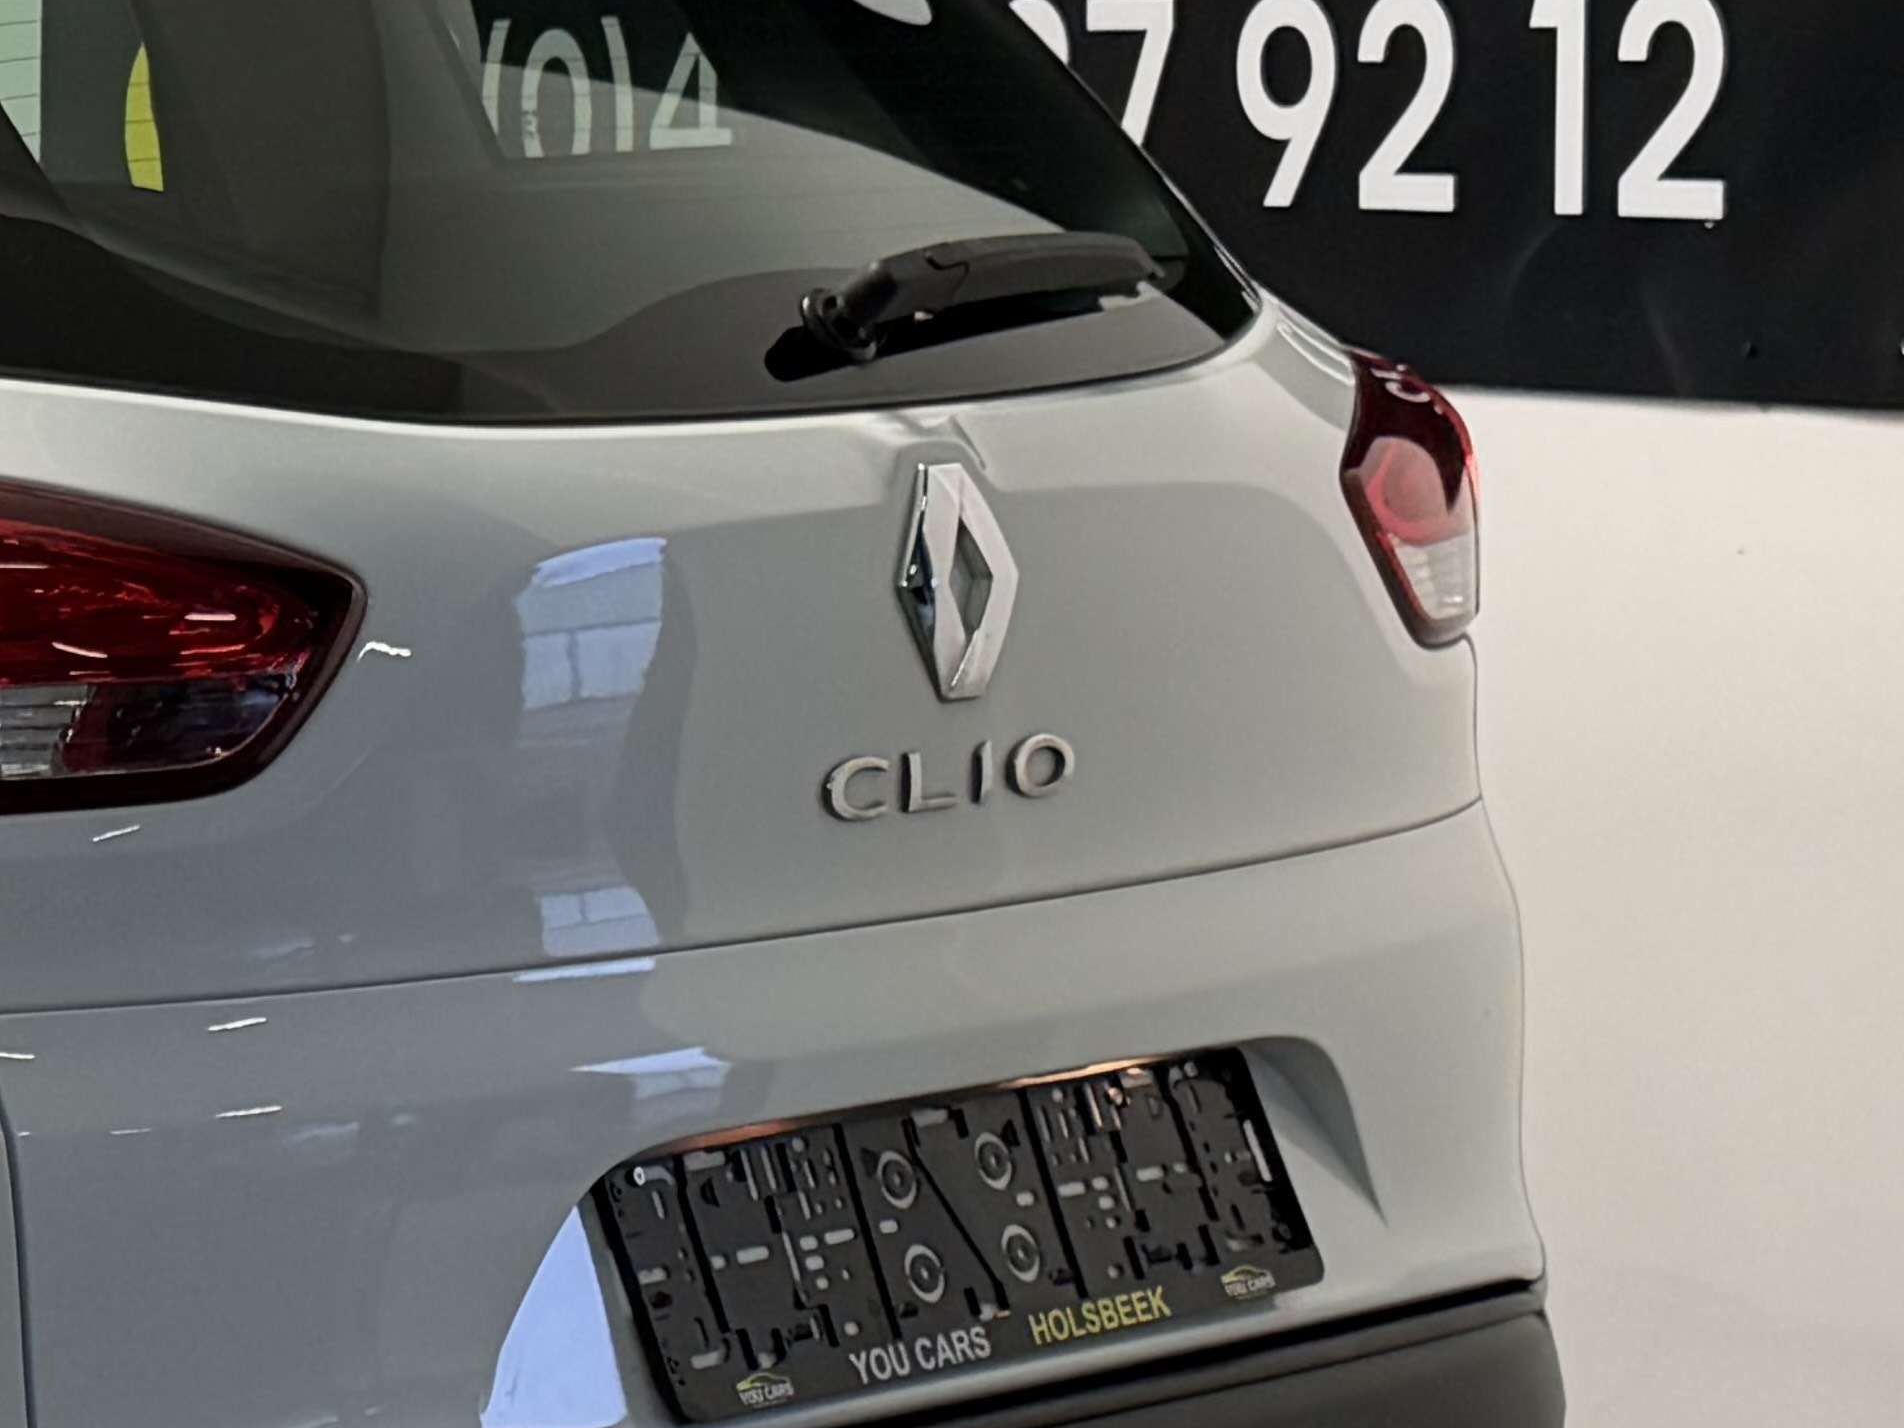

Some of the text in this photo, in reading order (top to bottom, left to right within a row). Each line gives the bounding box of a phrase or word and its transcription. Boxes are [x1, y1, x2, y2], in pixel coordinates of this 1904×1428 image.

[822, 732, 1076, 822] CLIO
[849, 1285, 1172, 1384] YOU CARS HOLSBEEK
